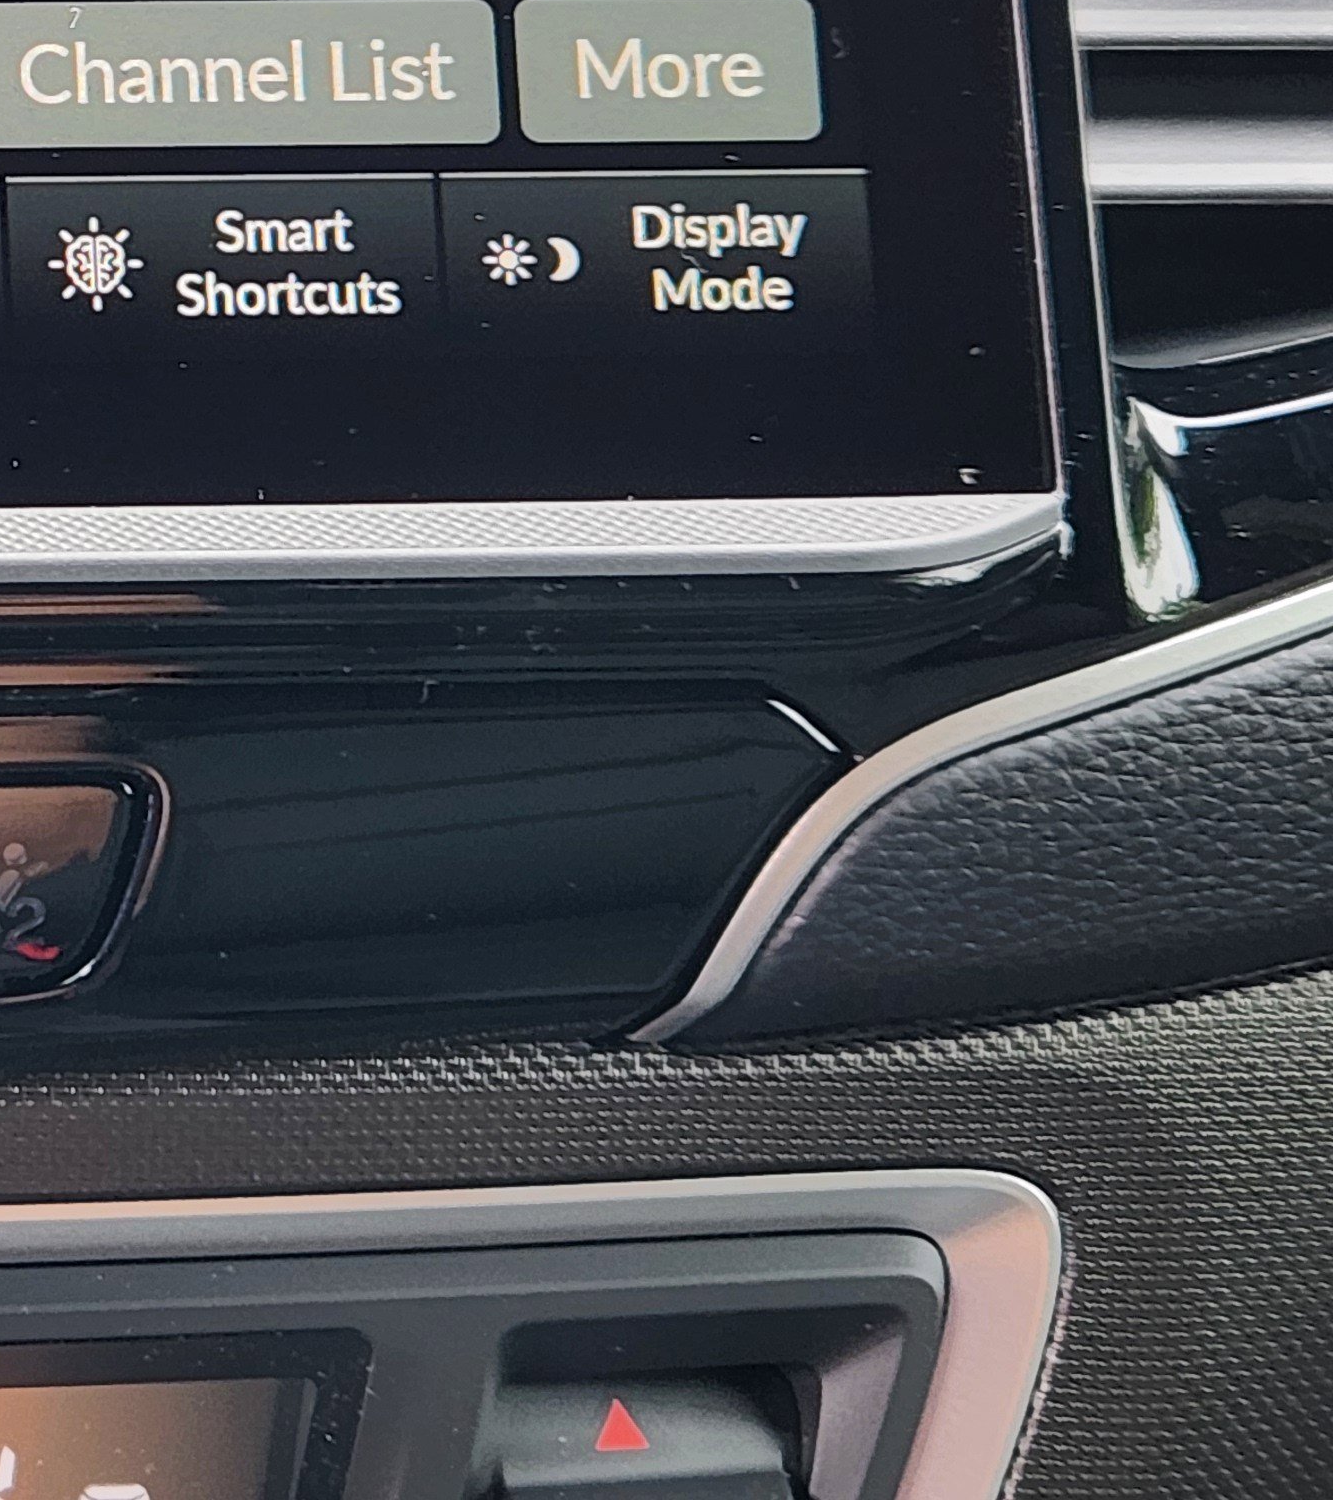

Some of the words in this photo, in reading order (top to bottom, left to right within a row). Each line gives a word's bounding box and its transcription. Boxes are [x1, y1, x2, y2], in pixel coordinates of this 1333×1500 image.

[20, 38, 306, 105] Channel
[329, 38, 457, 102] List
[575, 37, 764, 99] More
[215, 209, 355, 253] Smart
[632, 202, 806, 258] Display
[176, 270, 401, 317] Shortcuts
[652, 265, 794, 311] Mode
